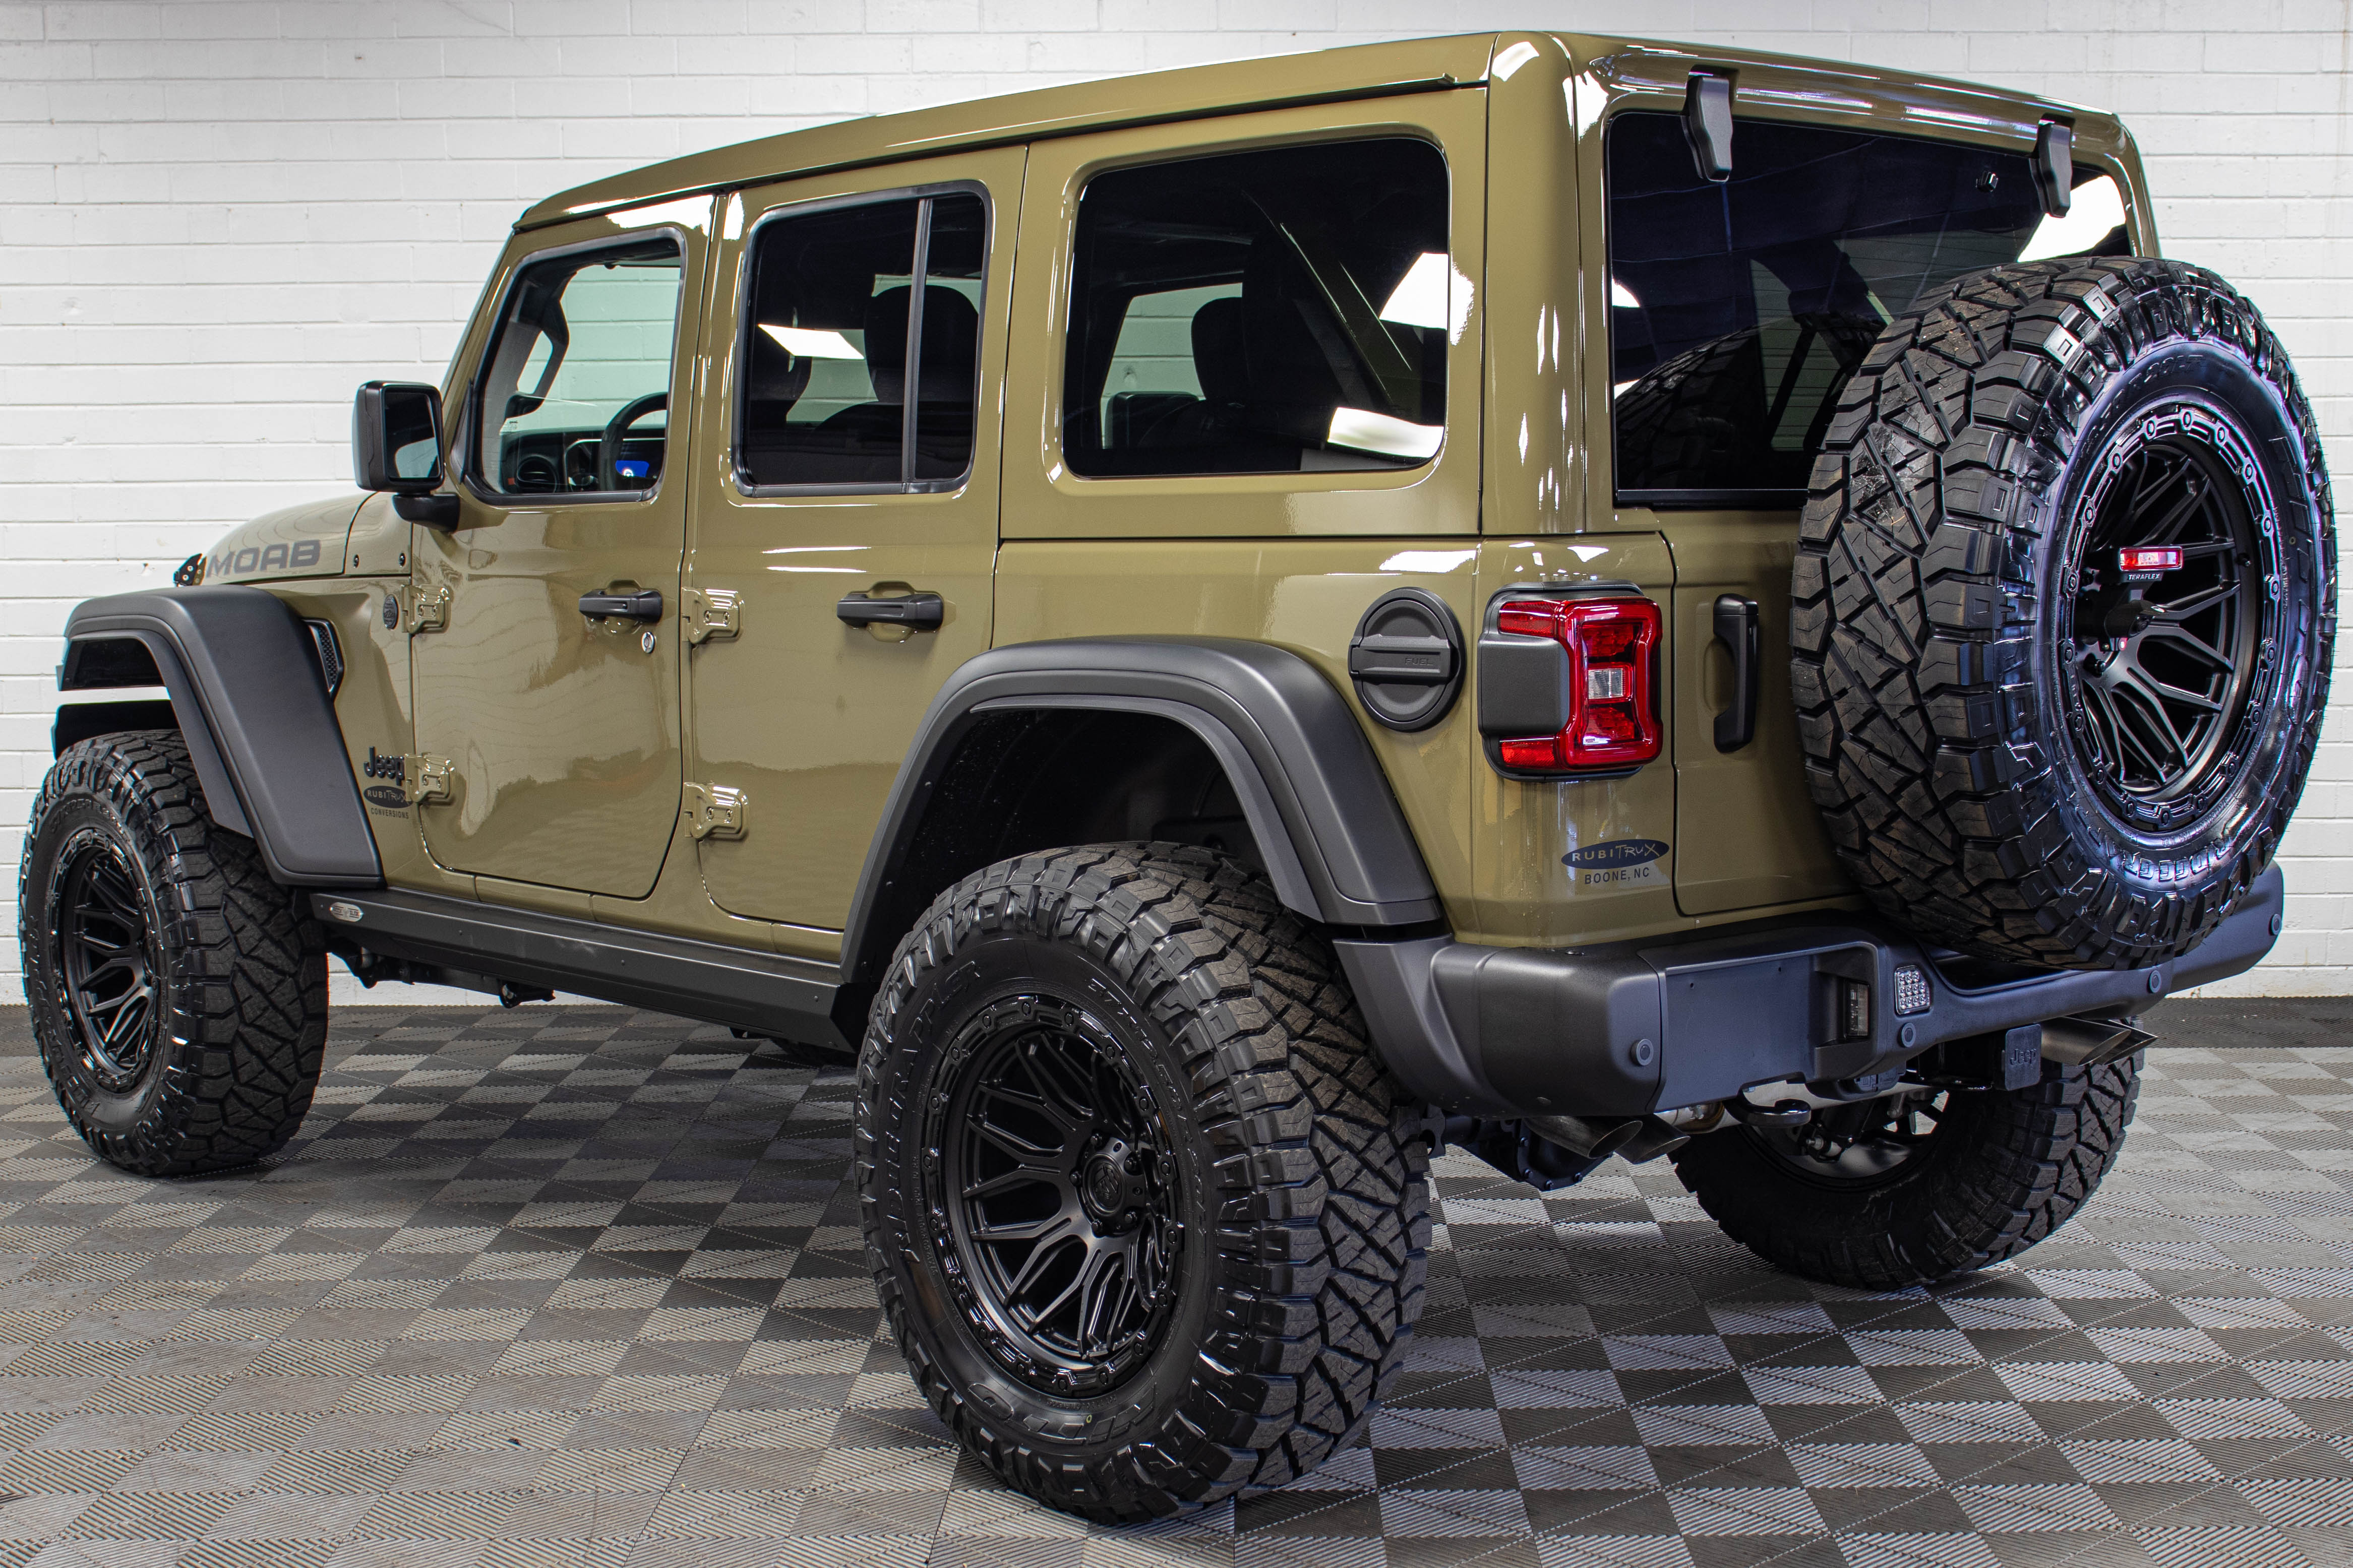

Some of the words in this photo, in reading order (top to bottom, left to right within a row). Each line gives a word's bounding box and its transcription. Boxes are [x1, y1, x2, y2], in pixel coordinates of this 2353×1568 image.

[205, 539, 321, 578] MOAB
[1405, 657, 1434, 666] FUEL
[364, 745, 405, 786] Jeep
[371, 807, 409, 819] CONVERSIONS
[1572, 843, 1660, 862] RUBITRUX
[1584, 869, 1631, 885] BOONE,
[1634, 867, 1650, 879] NC
[2009, 1048, 2037, 1067] Jeep
